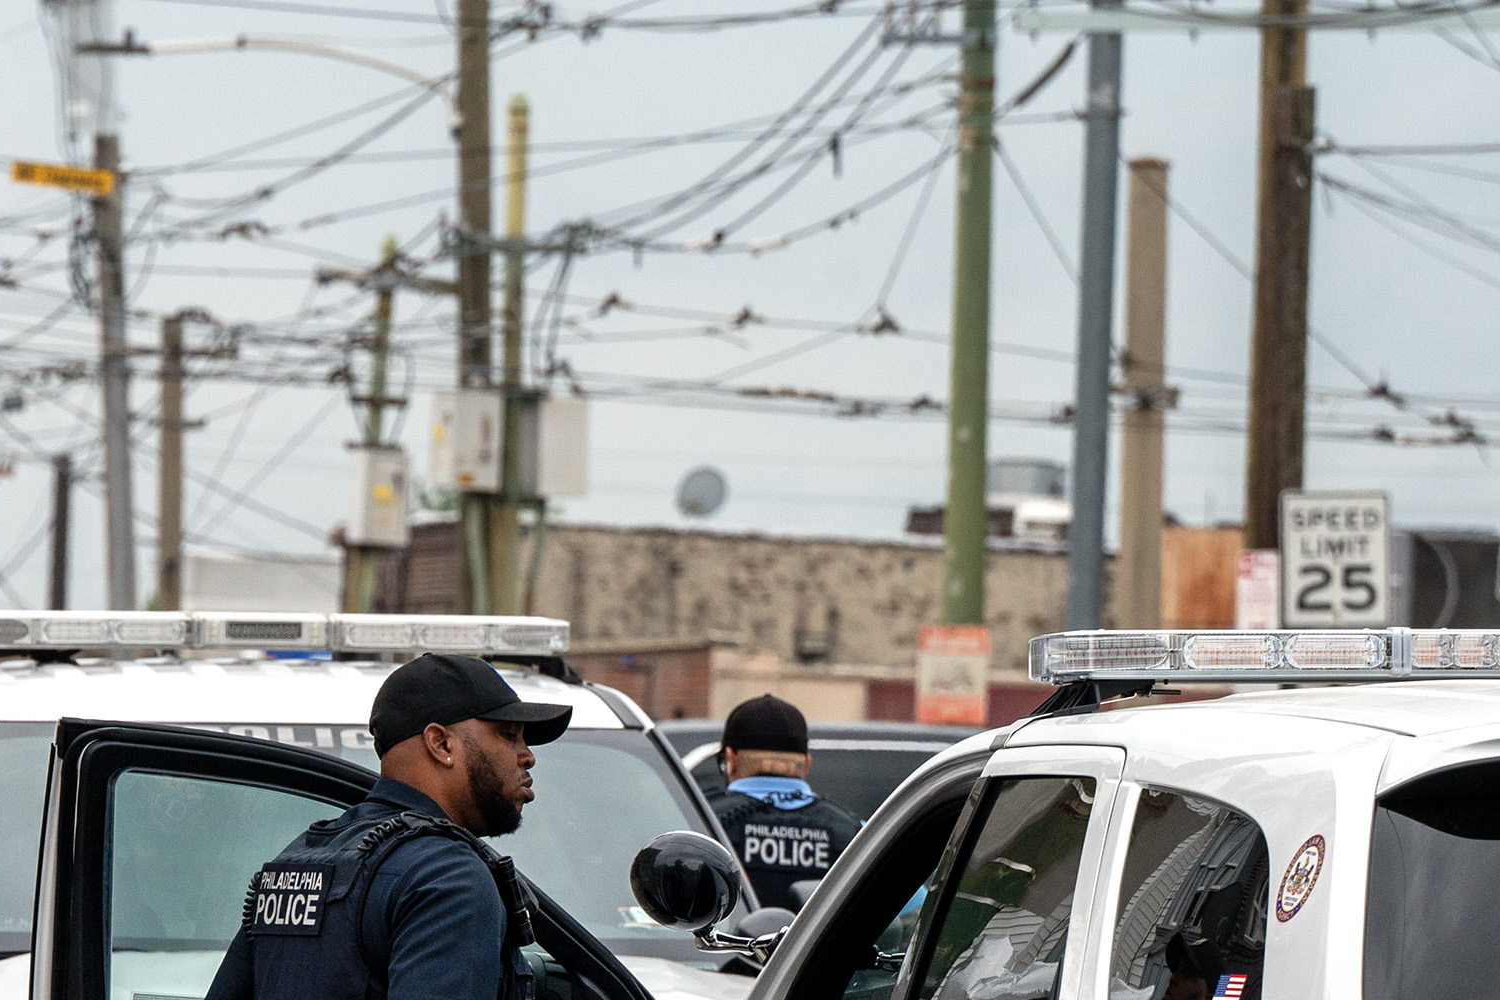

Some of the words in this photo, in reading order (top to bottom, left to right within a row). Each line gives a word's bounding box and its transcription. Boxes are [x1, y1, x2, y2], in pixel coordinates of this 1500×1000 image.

[1292, 506, 1379, 531] SPEED
[1301, 534, 1368, 558] LIMIT
[1297, 564, 1376, 611] 25
[745, 824, 829, 842] PHILADELPHIA
[745, 837, 829, 869] POLICE
[260, 872, 323, 890] PHILADELPHIA
[254, 893, 320, 926] POLICE
